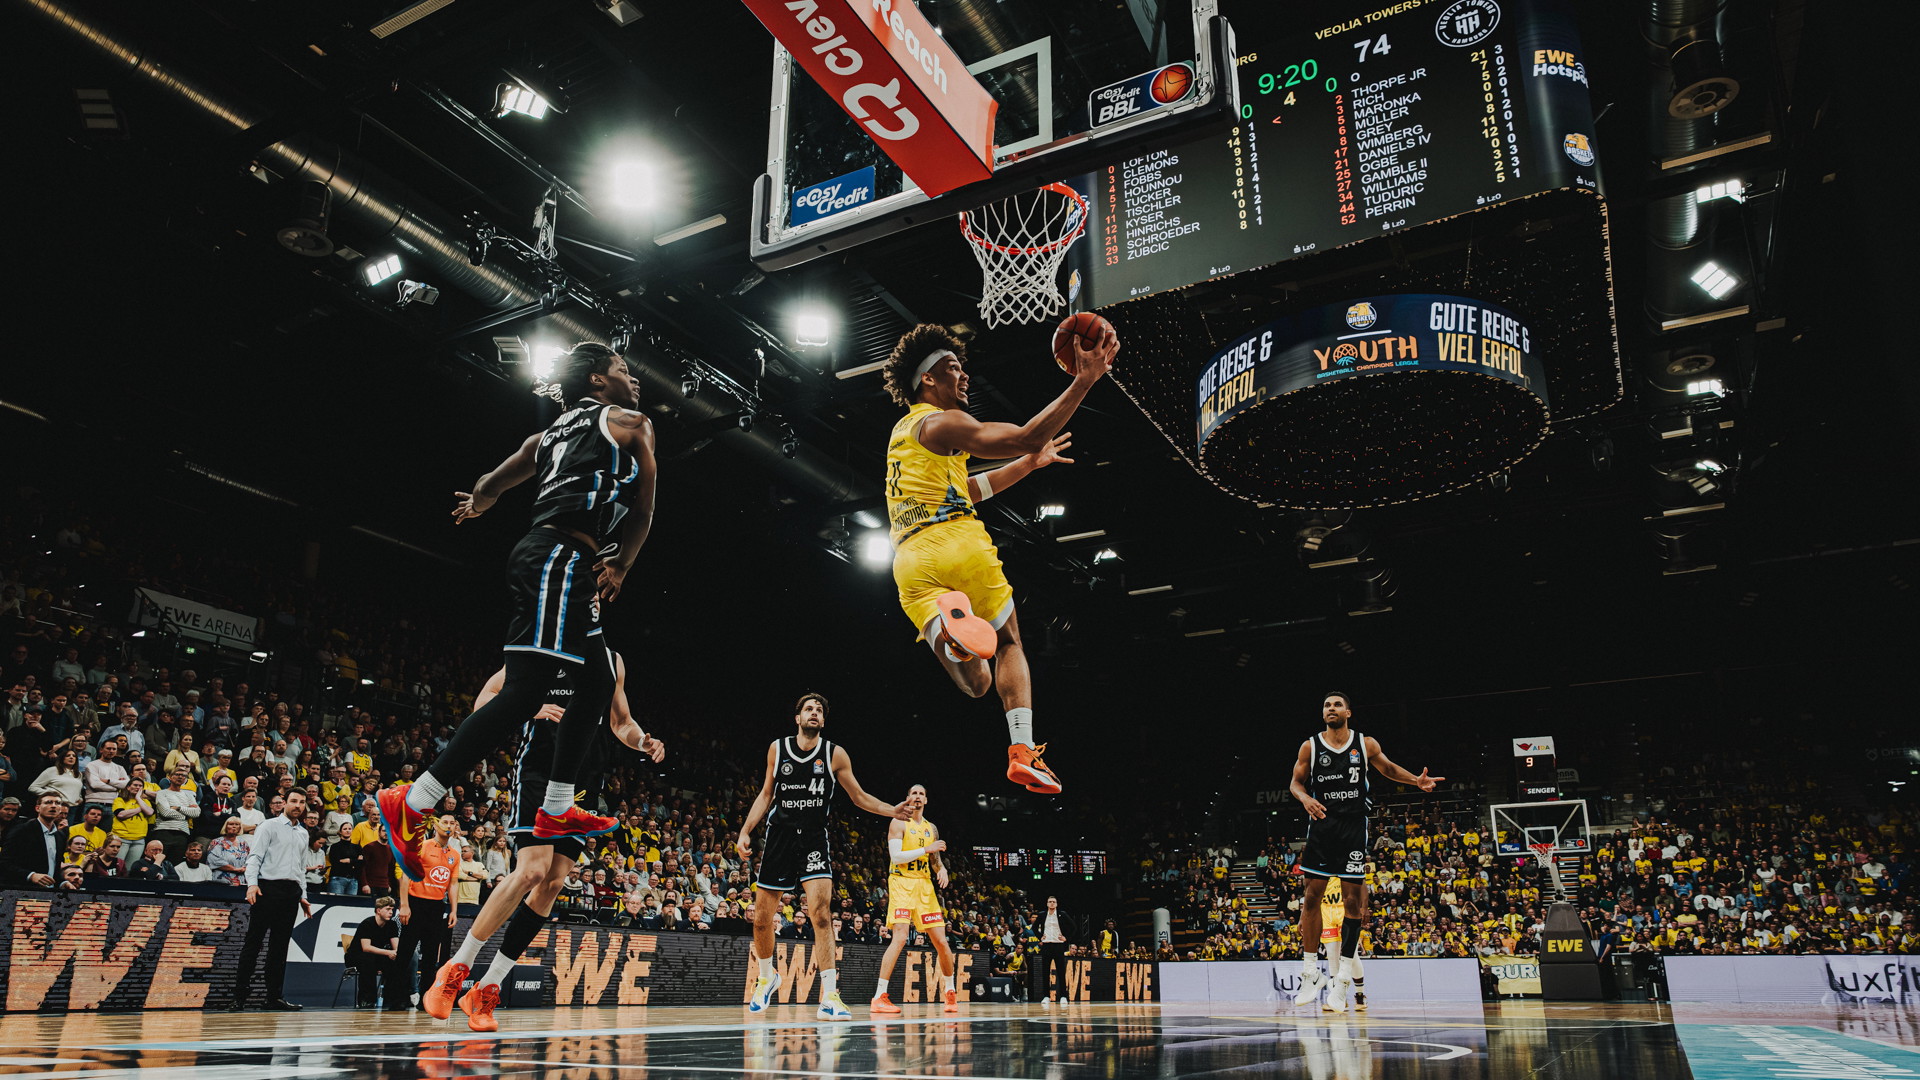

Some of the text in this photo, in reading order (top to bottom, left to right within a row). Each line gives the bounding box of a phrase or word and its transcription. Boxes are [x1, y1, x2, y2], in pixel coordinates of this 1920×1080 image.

[1315, 0, 1421, 40] VEOLIA TOWERS
[1456, 14, 1480, 35] HH
[1354, 34, 1391, 63] 74
[1534, 49, 1575, 67] EWE
[1110, 87, 1140, 103] Credit
[1259, 59, 1318, 94] 9:20
[1284, 92, 1296, 105] 4
[1326, 78, 1337, 92] 0
[1335, 45, 1503, 104] 2 THORPE JR 21 3
[1336, 56, 1504, 115] 3 RICH 7 0
[1338, 66, 1506, 125] 5 MARONKA 5 2
[1098, 97, 1140, 123] BBL
[1242, 104, 1252, 118] 0
[1334, 99, 1511, 158] 17 WIMBERG 8 2
[1338, 77, 1507, 135] 6 MÜLLER 0 0
[1340, 88, 1508, 146] 8 GREY 0 1
[1108, 166, 1115, 174] 0
[1232, 127, 1239, 136] 9
[1248, 122, 1254, 131] 1
[1109, 132, 1256, 184] 3 CLEMONS 14 3
[1335, 110, 1512, 170] 21 DANIELS IV 11 0
[1336, 121, 1513, 181] 25 OGBE 12 1
[1337, 133, 1516, 192] 27 GAMBLE II 0 0
[1108, 142, 1256, 193] 4 FOBBS 9 1
[1110, 152, 1258, 203] 5 HOUNNOU 3 2
[1110, 162, 1257, 213] 7 TUCKER 0 1
[1338, 144, 1518, 203] 34 WILLIAMS 3 3
[1339, 156, 1520, 213] 44 TUDURIC 2 3
[817, 186, 869, 215] Credit
[1105, 173, 1260, 224] 11 TISCHLER 8 4
[1105, 184, 1259, 235] 12 KYSER 11 1
[1105, 194, 1262, 246] 21 HINRICHS 0 2
[1341, 168, 1520, 225] 52 PERRIN 5 1
[1105, 205, 1261, 256] 29 SCHROEDER 0 1
[1106, 216, 1262, 266] 33 ZUBCIC 8 1
[1348, 314, 1375, 323] BASKETS
[1430, 302, 1530, 354] GUTE REISE &
[1200, 330, 1273, 408] GUTE REISE &
[1316, 367, 1355, 379] BASKETBALL
[1356, 362, 1394, 371] CHAMPIONS
[1438, 332, 1477, 364] VIEL
[163, 606, 252, 640] EWE ARENA
[808, 778, 825, 795] 44
[1348, 767, 1360, 784] 25
[1525, 757, 1533, 767] 9
[782, 797, 823, 810] nexperia
[1547, 939, 1584, 953] EWE
[903, 951, 973, 1003] EWE
[1115, 962, 1152, 1001] EWE
